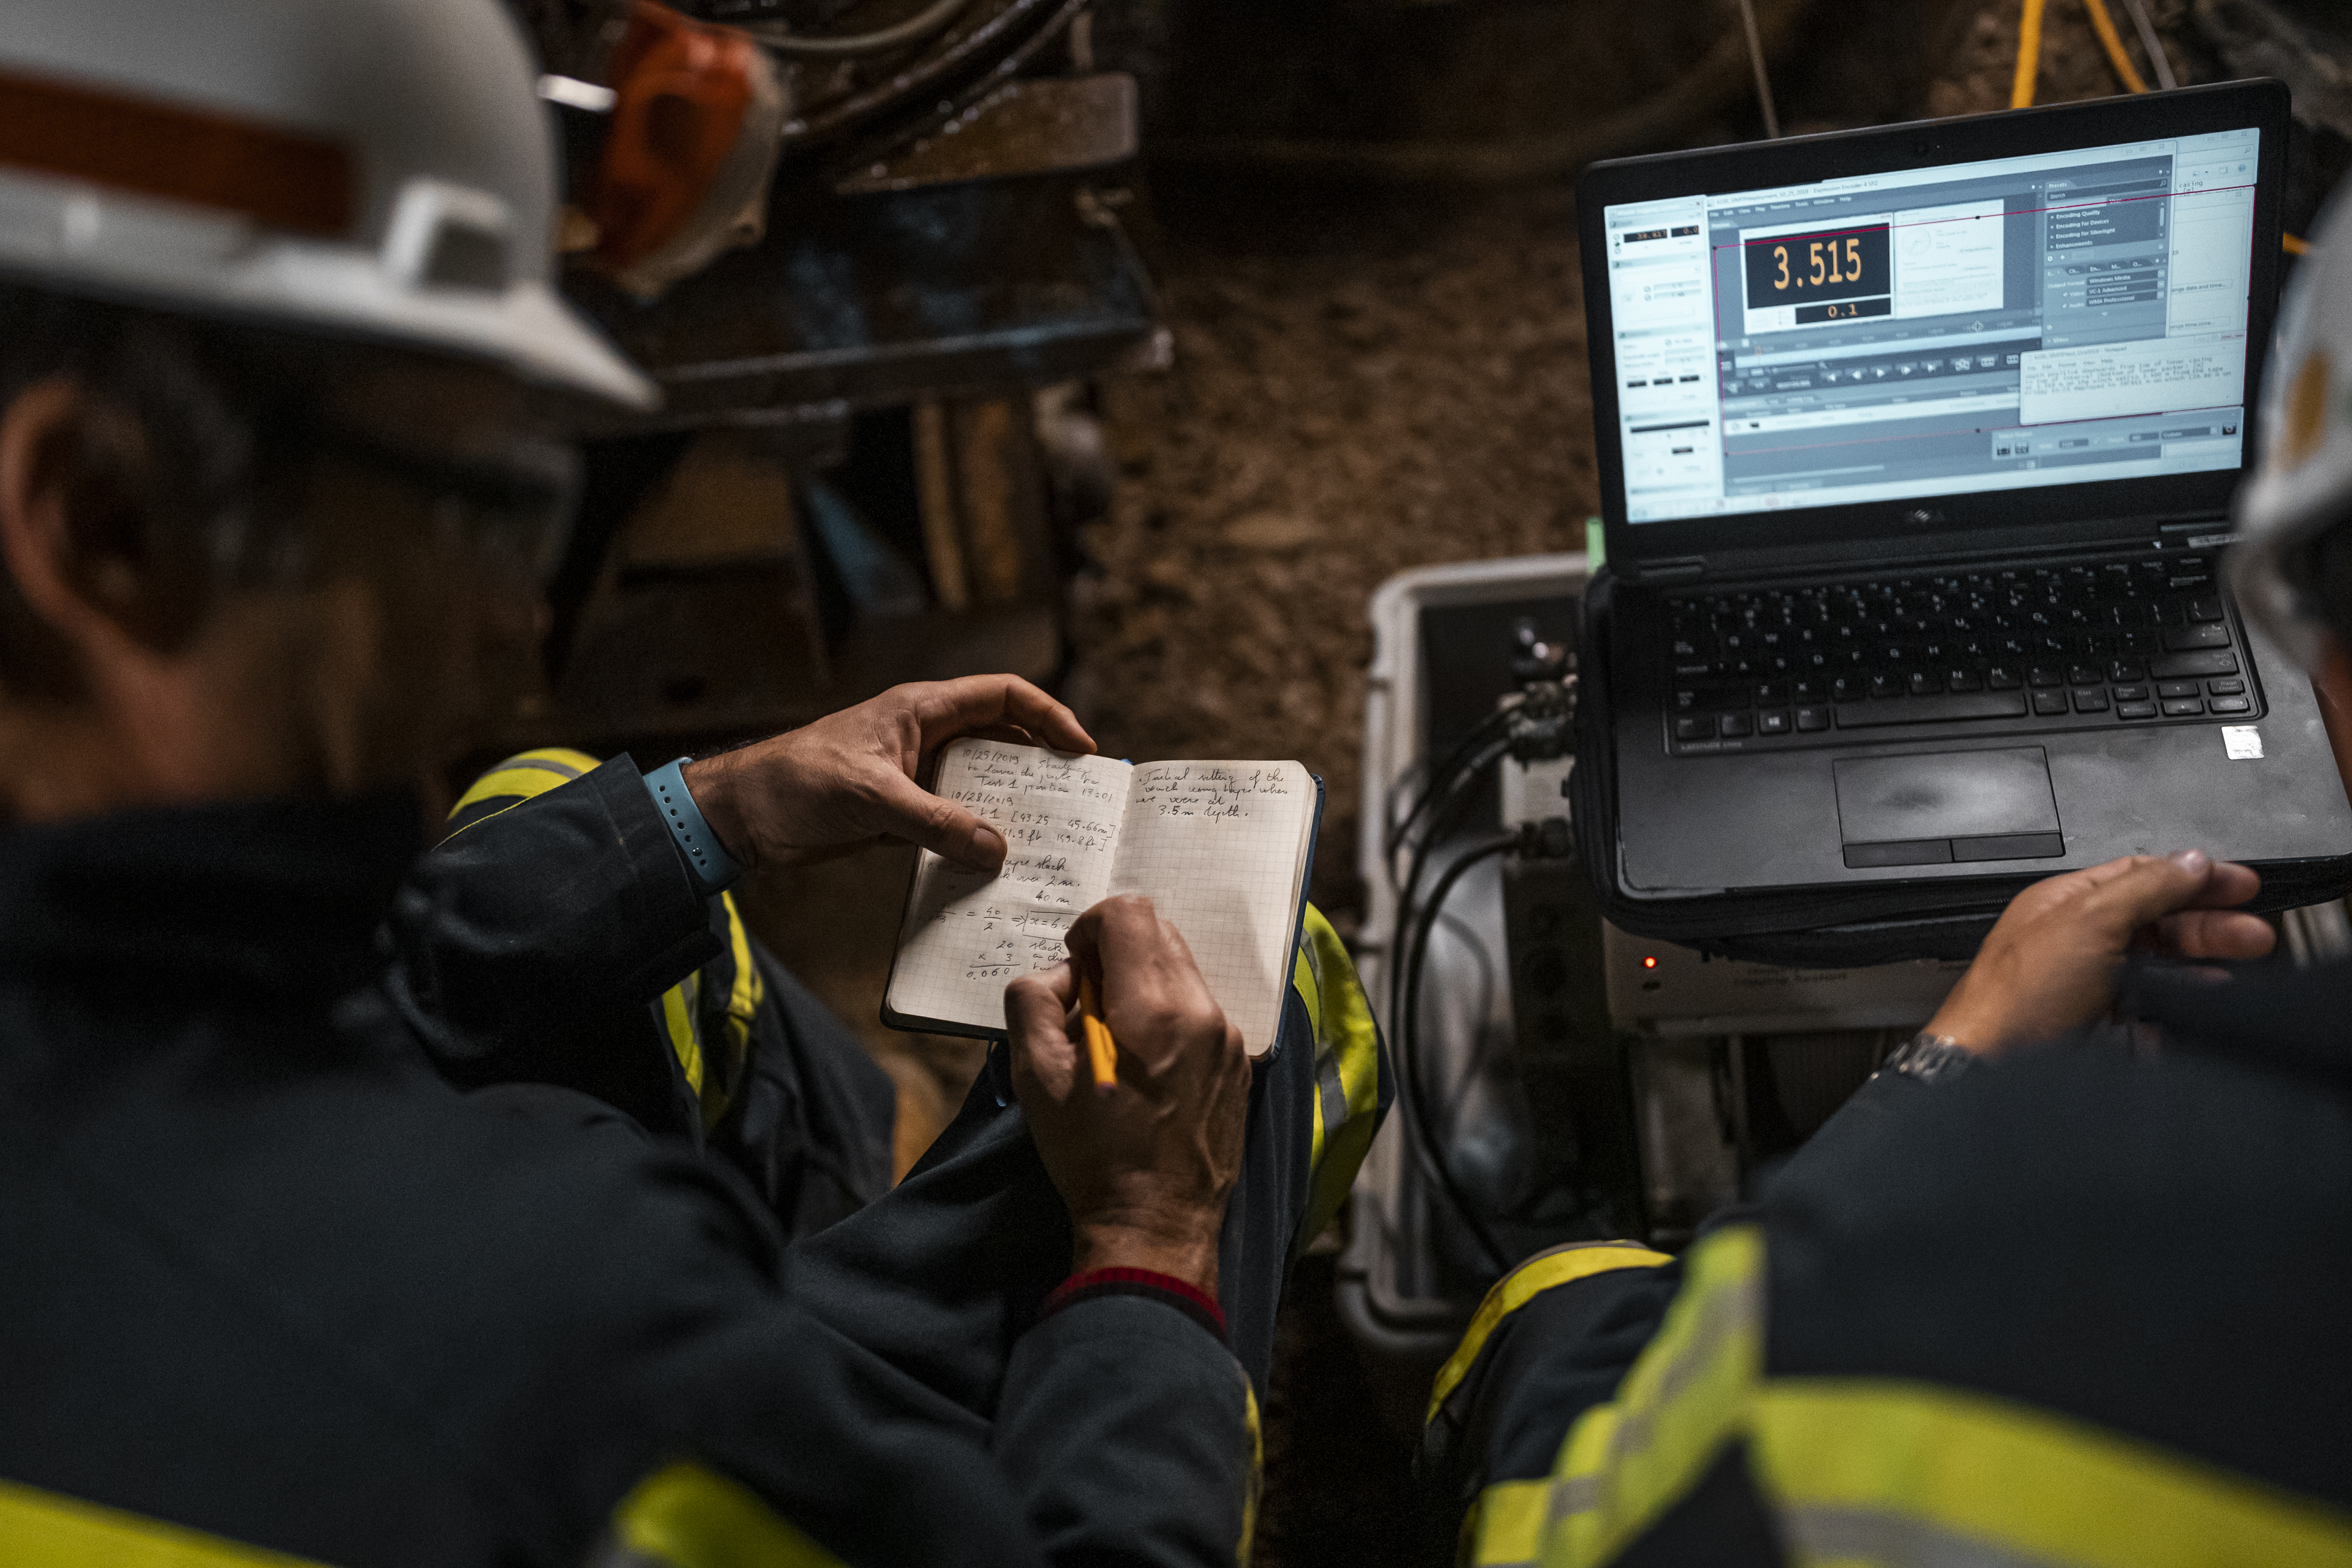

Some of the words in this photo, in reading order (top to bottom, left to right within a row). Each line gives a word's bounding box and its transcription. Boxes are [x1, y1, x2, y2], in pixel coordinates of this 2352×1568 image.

[2056, 241, 2093, 249] Enhancements
[1774, 238, 1862, 290] 3.515
[1828, 303, 1858, 318] 0.1
[963, 749, 1019, 764] 10/25/2019
[1250, 770, 1260, 788] of
[1267, 768, 1283, 781] the
[974, 776, 1004, 787] Test
[1008, 779, 1018, 788] 1
[1082, 789, 1112, 803] 13:01
[952, 791, 1013, 806] 10/28/2019
[1034, 855, 1069, 871] slack
[1035, 890, 1050, 901] 40
[983, 922, 992, 931] 2
[996, 940, 1014, 949] 20
[1029, 939, 1065, 954] slack
[966, 968, 1011, 980] 0.060
